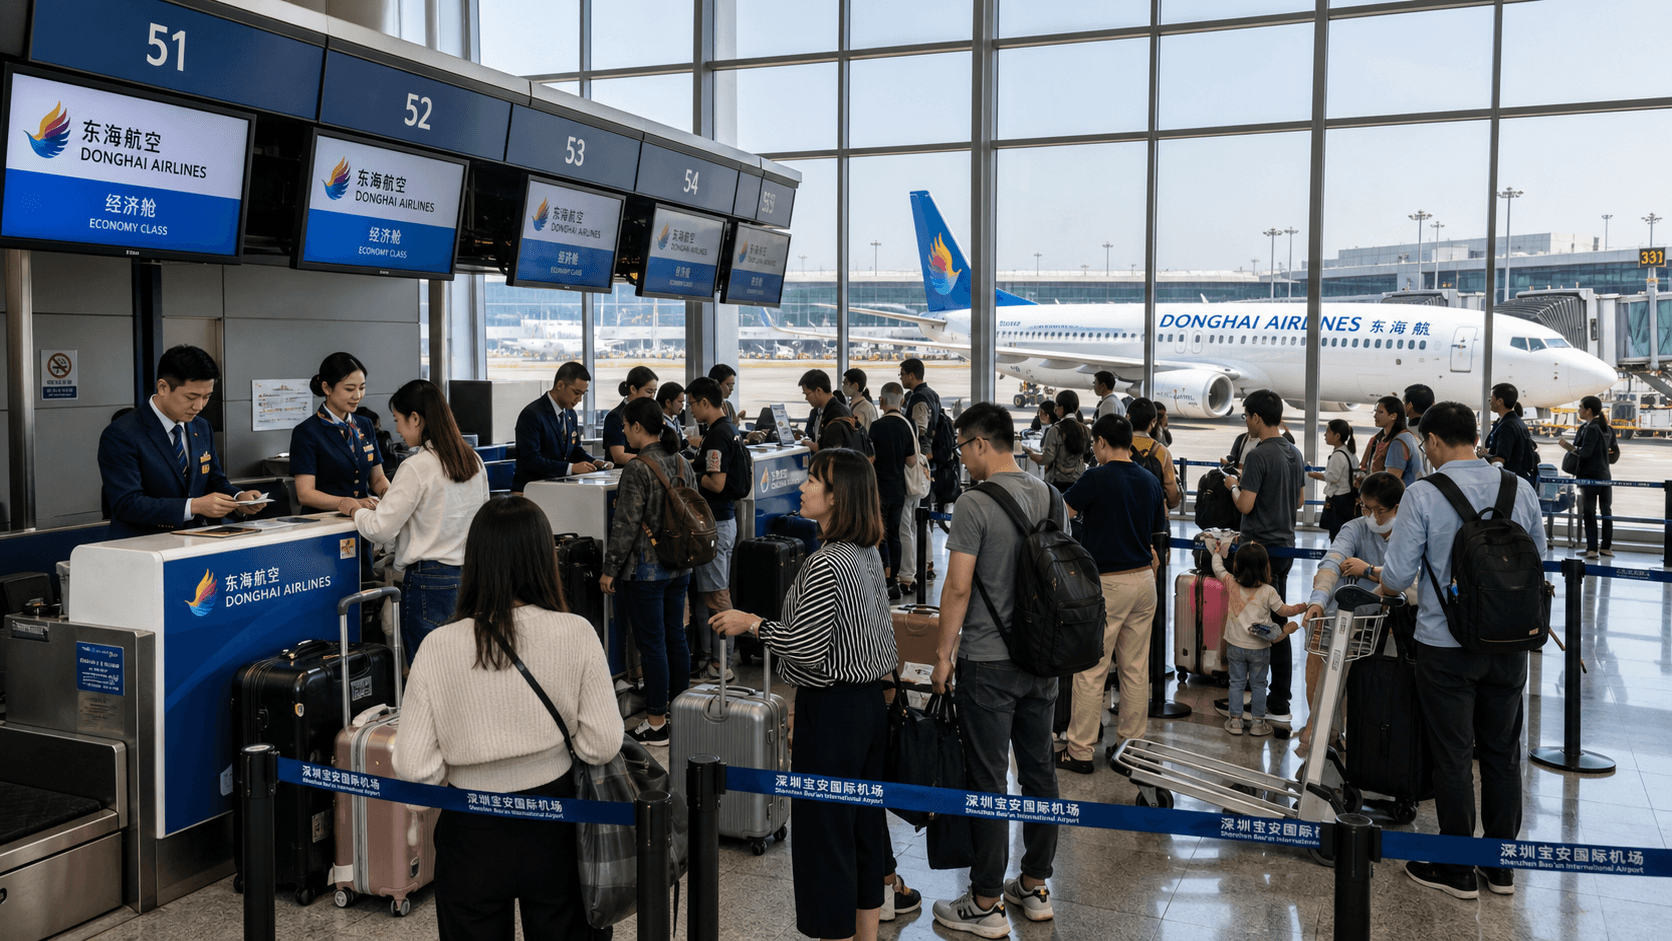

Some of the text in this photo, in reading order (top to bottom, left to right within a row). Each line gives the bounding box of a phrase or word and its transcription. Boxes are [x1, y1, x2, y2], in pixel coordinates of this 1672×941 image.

[146, 22, 186, 72] 51
[404, 92, 432, 130] 52
[82, 119, 161, 153] 东海航空
[81, 147, 207, 179] DONGHAI AIRLINES
[565, 135, 585, 167] 53
[357, 168, 407, 194] 东海航空
[683, 168, 699, 195] 54
[105, 193, 157, 218] 经济舱
[355, 190, 435, 213] DONGHAI AIRLINES
[89, 218, 168, 236] ECONOMY CLASS
[1641, 250, 1663, 264] 331
[1159, 314, 1362, 332] DONGHAI AIRLNES
[225, 566, 280, 592] 东海航空
[226, 575, 331, 608] DONGHAI AIRLINES
[775, 774, 884, 798] 深圳宝安国际机场
[966, 794, 1080, 817] 深圳宝安国际机场
[1500, 843, 1644, 866] 深圳宝安国际机场
